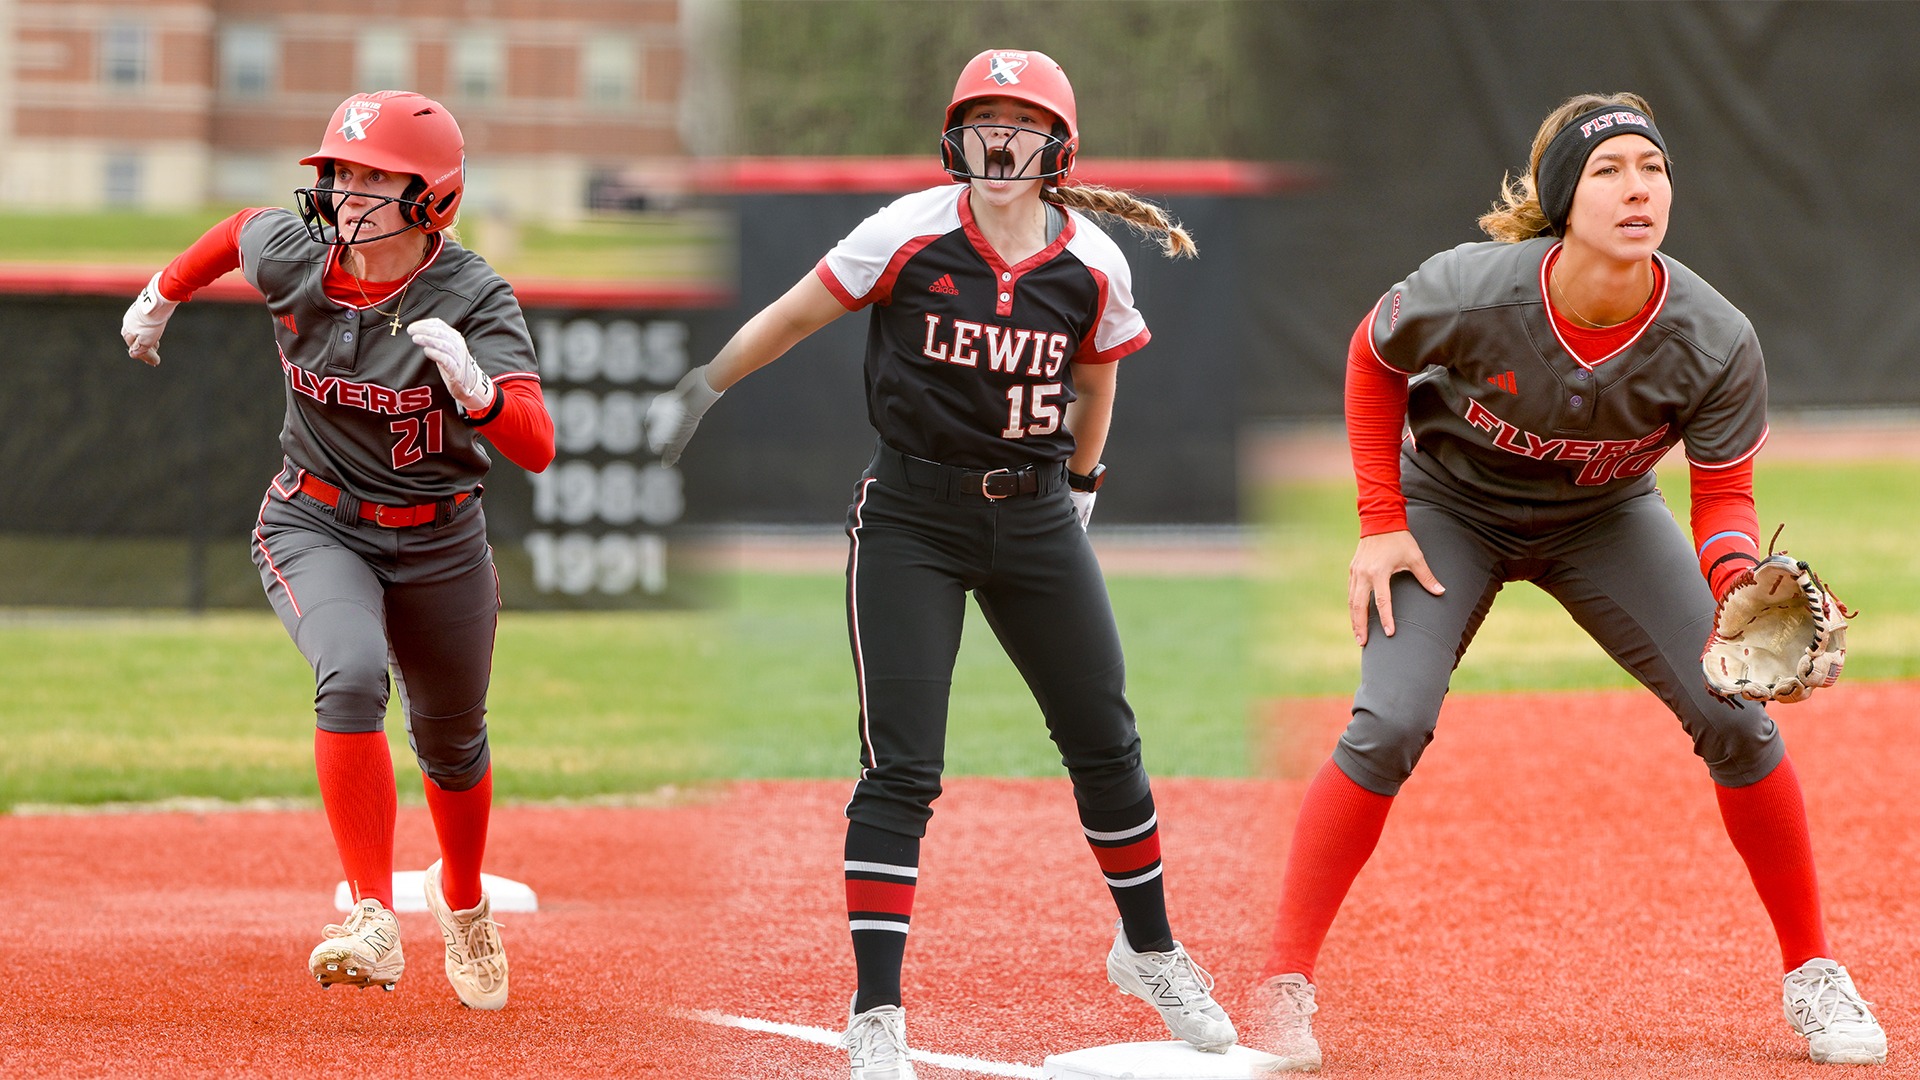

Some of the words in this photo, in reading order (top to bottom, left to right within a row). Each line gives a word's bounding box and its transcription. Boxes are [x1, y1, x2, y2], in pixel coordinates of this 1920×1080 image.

[350, 101, 382, 109] LEWIS
[1580, 112, 1649, 138] FLYERS
[929, 285, 960, 296] adidas
[534, 319, 689, 383] 1985
[922, 312, 1068, 378] LEWIS
[390, 409, 443, 470] 21
[1001, 381, 1062, 439] 15
[1463, 397, 1670, 462] FLYERS
[1575, 445, 1670, 487] 00
[523, 530, 667, 594] 1991
